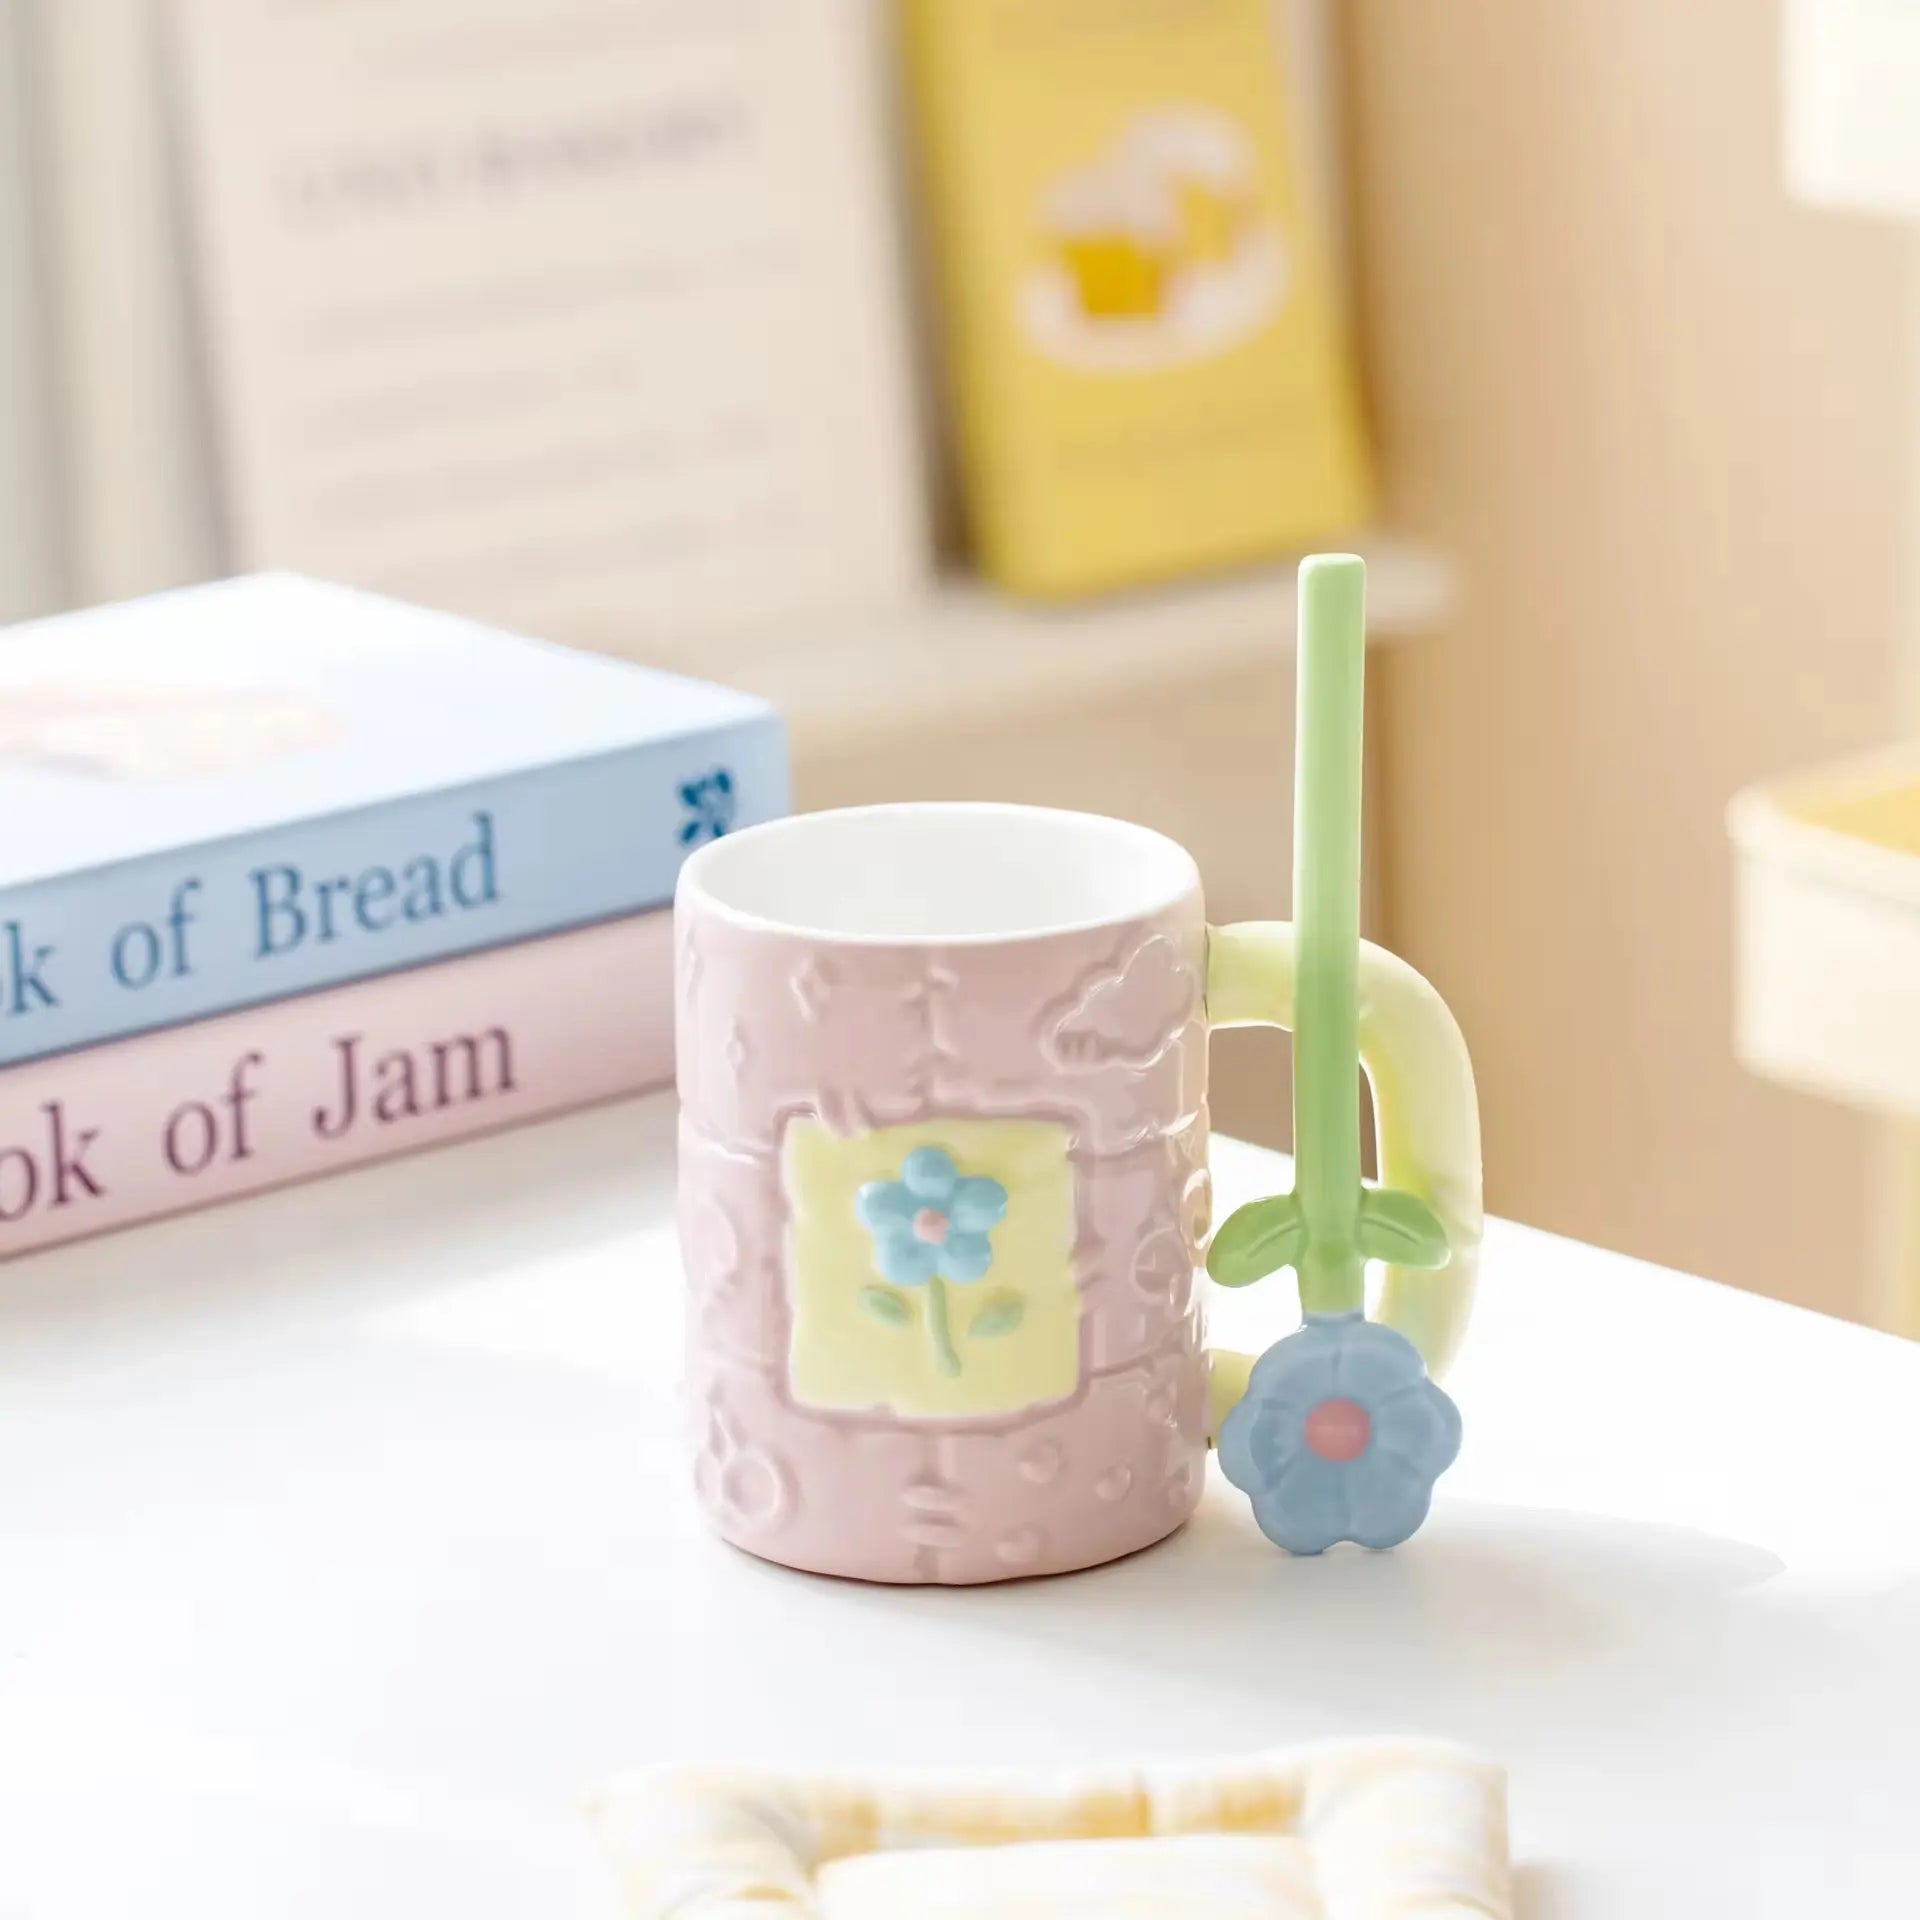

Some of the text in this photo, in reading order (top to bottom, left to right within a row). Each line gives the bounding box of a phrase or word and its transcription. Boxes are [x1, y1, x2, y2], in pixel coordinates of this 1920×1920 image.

[0, 811, 501, 1016] k of Bread
[161, 1051, 265, 1177] of
[312, 1025, 518, 1139] Jam
